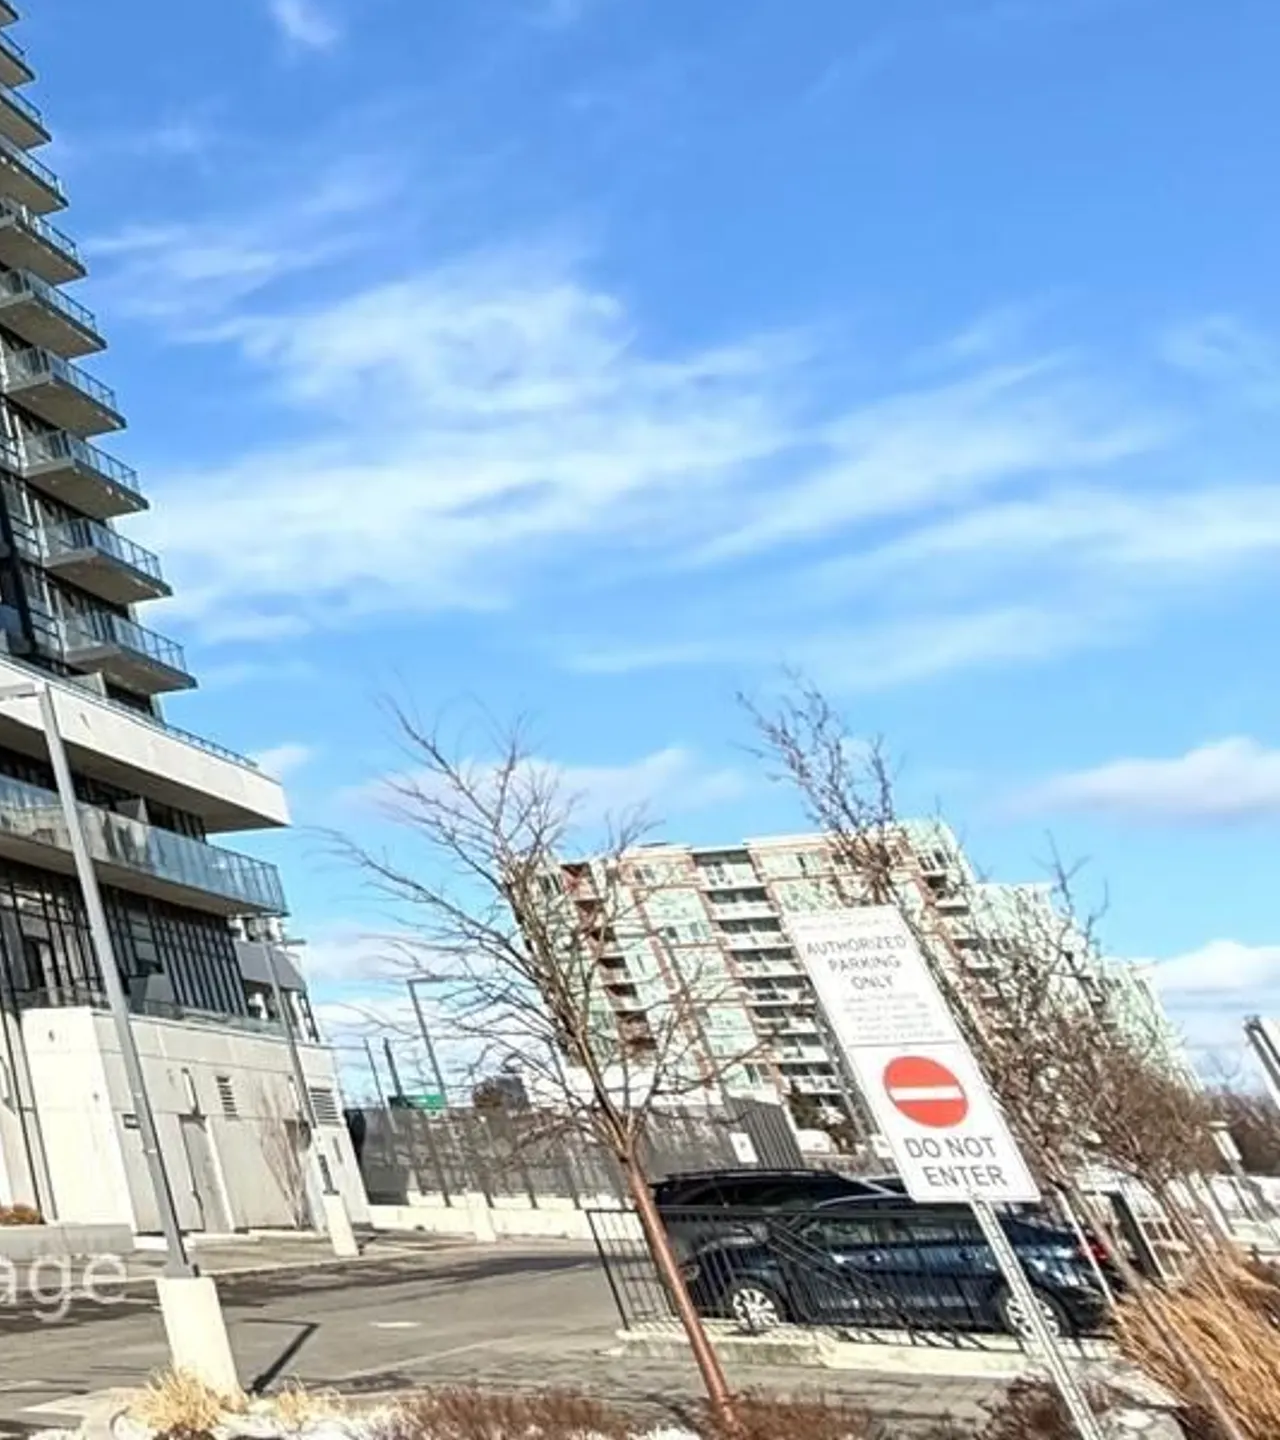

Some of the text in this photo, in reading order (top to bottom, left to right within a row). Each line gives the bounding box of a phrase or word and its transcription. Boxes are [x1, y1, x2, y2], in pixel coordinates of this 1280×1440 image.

[806, 933, 907, 956] AUTHORIZED
[827, 953, 903, 972] PARKING
[850, 974, 894, 990] ONLY
[903, 1136, 997, 1159] DO NOT
[921, 1164, 1009, 1187] ENTER
